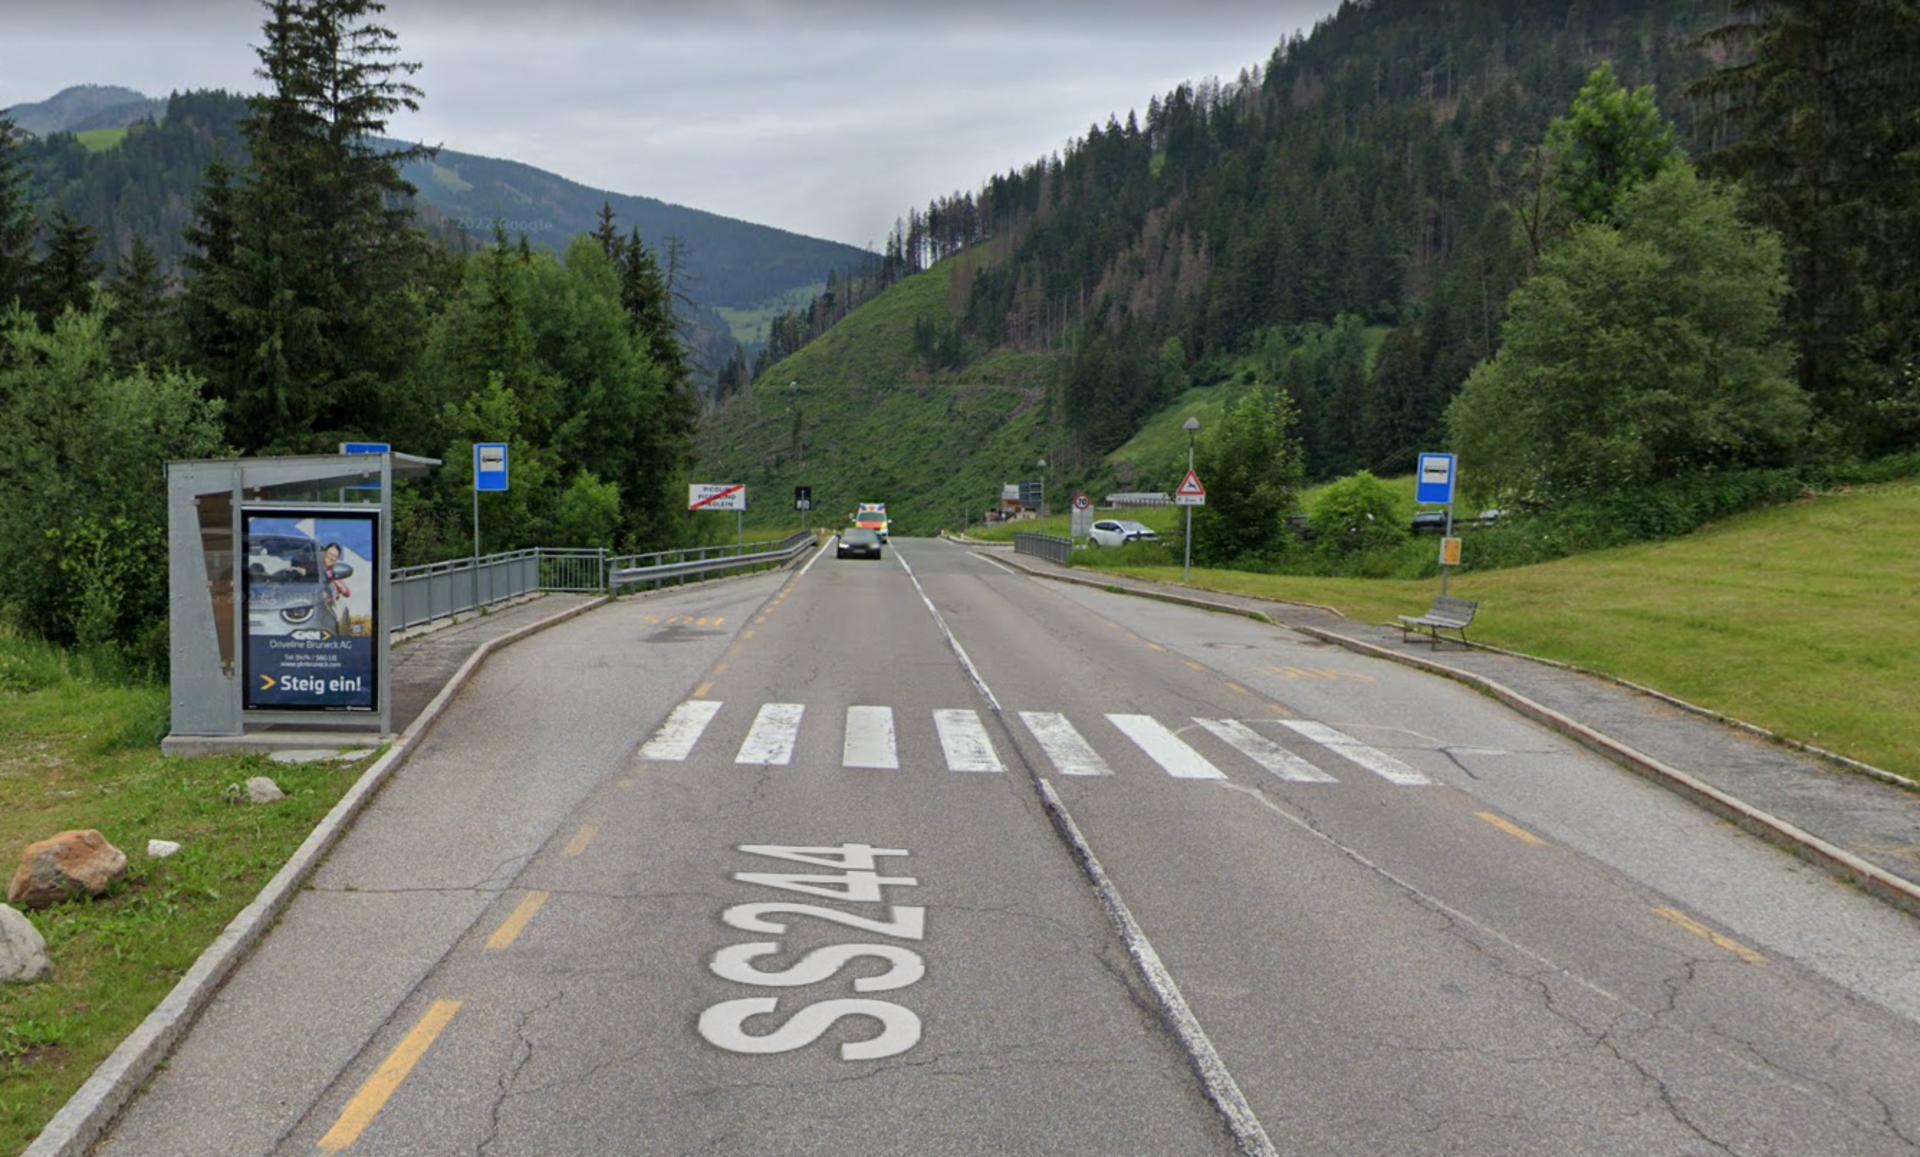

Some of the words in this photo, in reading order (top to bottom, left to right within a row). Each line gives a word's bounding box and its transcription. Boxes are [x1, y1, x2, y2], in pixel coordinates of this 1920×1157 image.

[269, 639, 305, 649] Driveline
[306, 640, 338, 649] Bruneck
[339, 640, 352, 649] AG
[280, 675, 325, 695] Steig
[329, 675, 362, 692] ein!
[698, 843, 925, 1061] SS244
